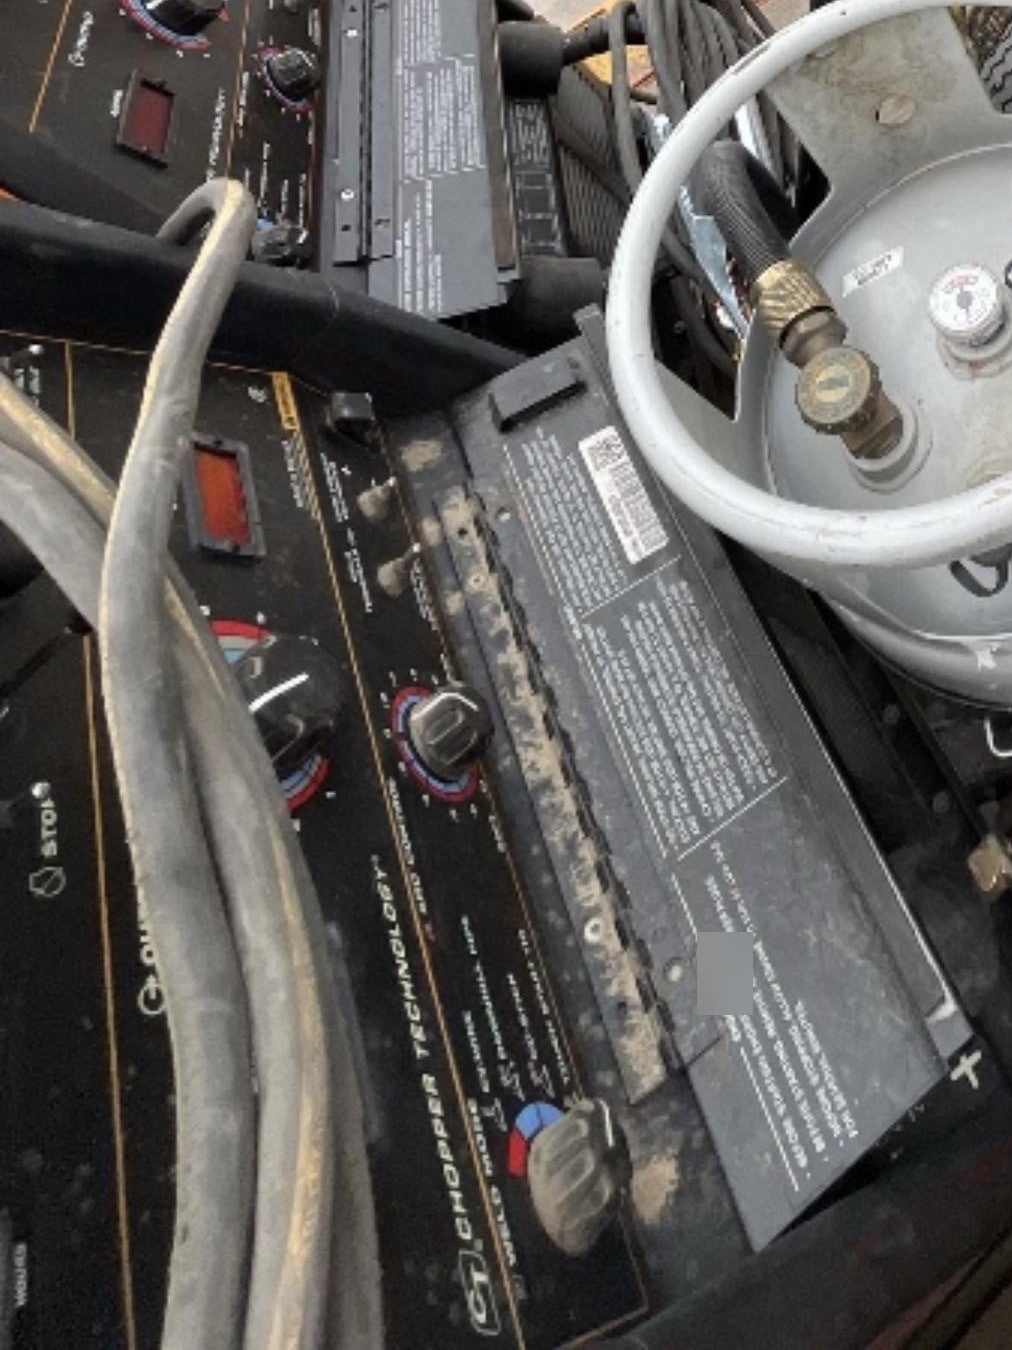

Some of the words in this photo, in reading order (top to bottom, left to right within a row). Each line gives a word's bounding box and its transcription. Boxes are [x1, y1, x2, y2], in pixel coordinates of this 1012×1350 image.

[421, 1072, 473, 1240] CHOPPER
[467, 1098, 493, 1177] MODE
[490, 1184, 517, 1267] WELD
